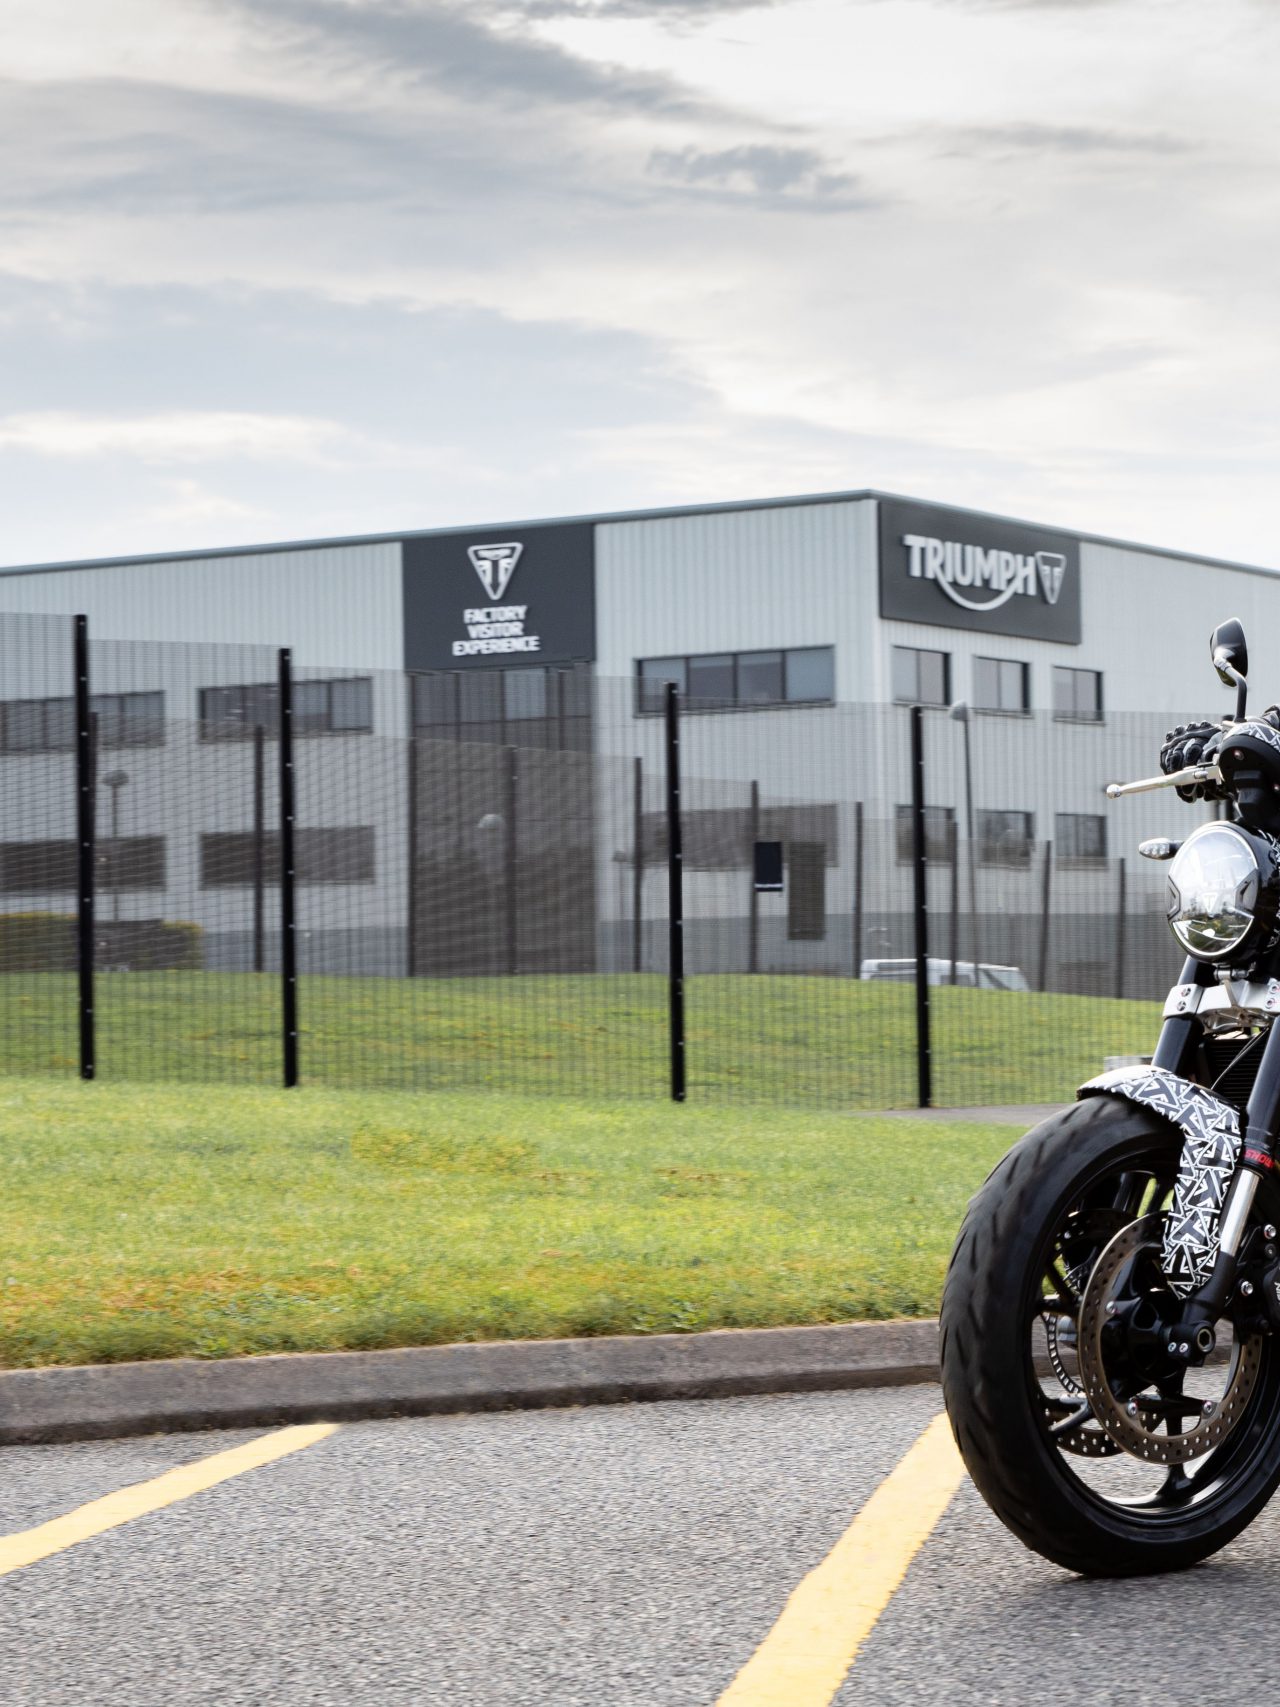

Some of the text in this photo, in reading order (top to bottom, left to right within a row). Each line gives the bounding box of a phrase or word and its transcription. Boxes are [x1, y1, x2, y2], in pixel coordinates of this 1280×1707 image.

[904, 534, 1037, 611] TRIUMPH
[463, 605, 528, 624] FACTORY
[467, 621, 524, 639] VISITOR
[452, 636, 541, 656] EXPERIENCE
